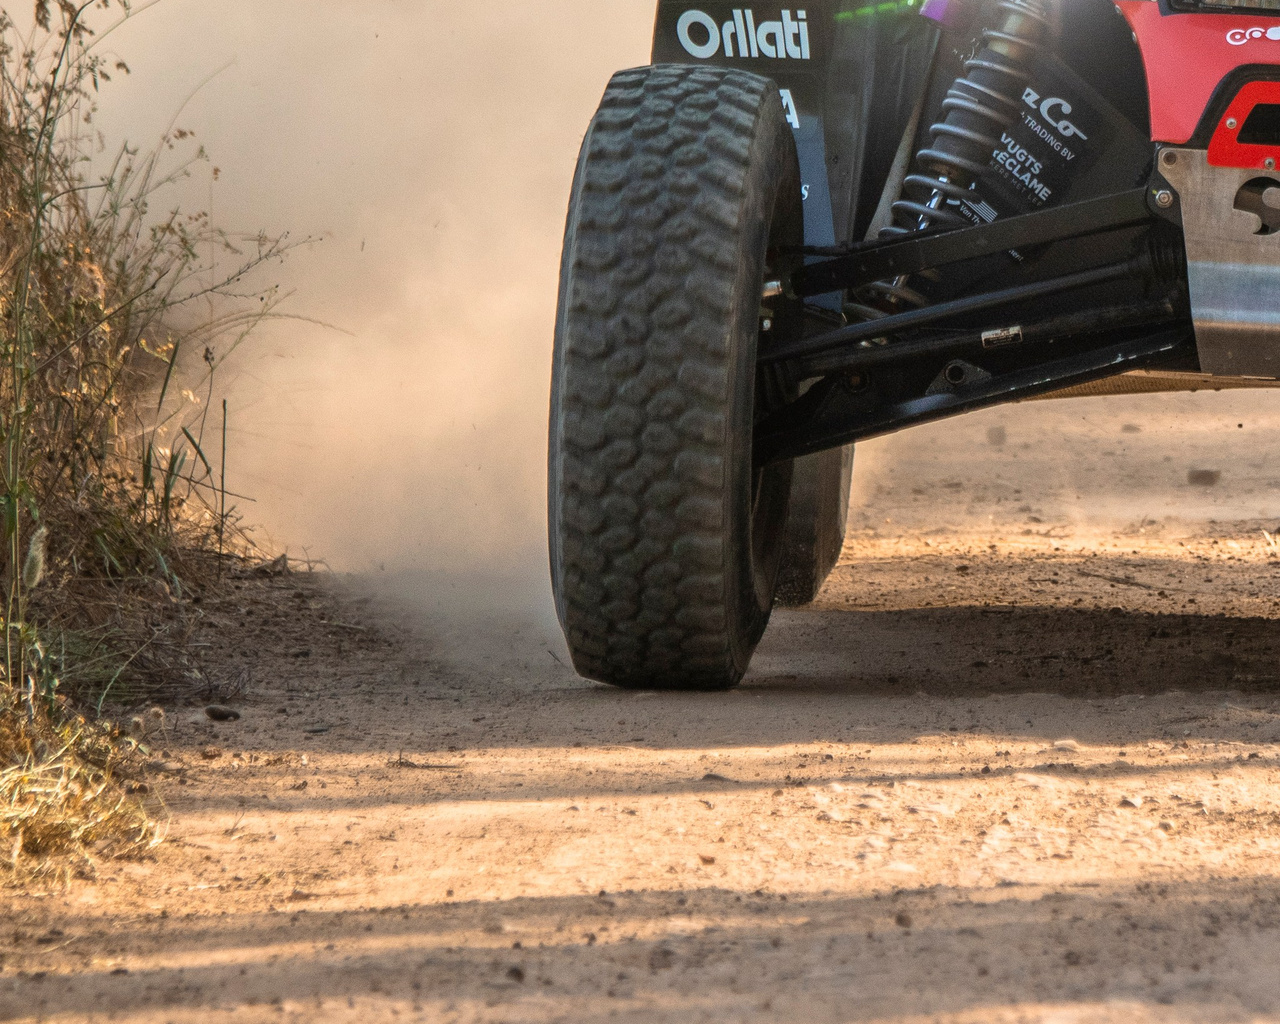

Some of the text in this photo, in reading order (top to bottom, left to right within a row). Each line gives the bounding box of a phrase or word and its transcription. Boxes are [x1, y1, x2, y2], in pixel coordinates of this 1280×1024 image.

[676, 9, 811, 60] Orllati
[1000, 132, 1043, 175] VUGTS
[1024, 115, 1076, 161] TRADING BV
